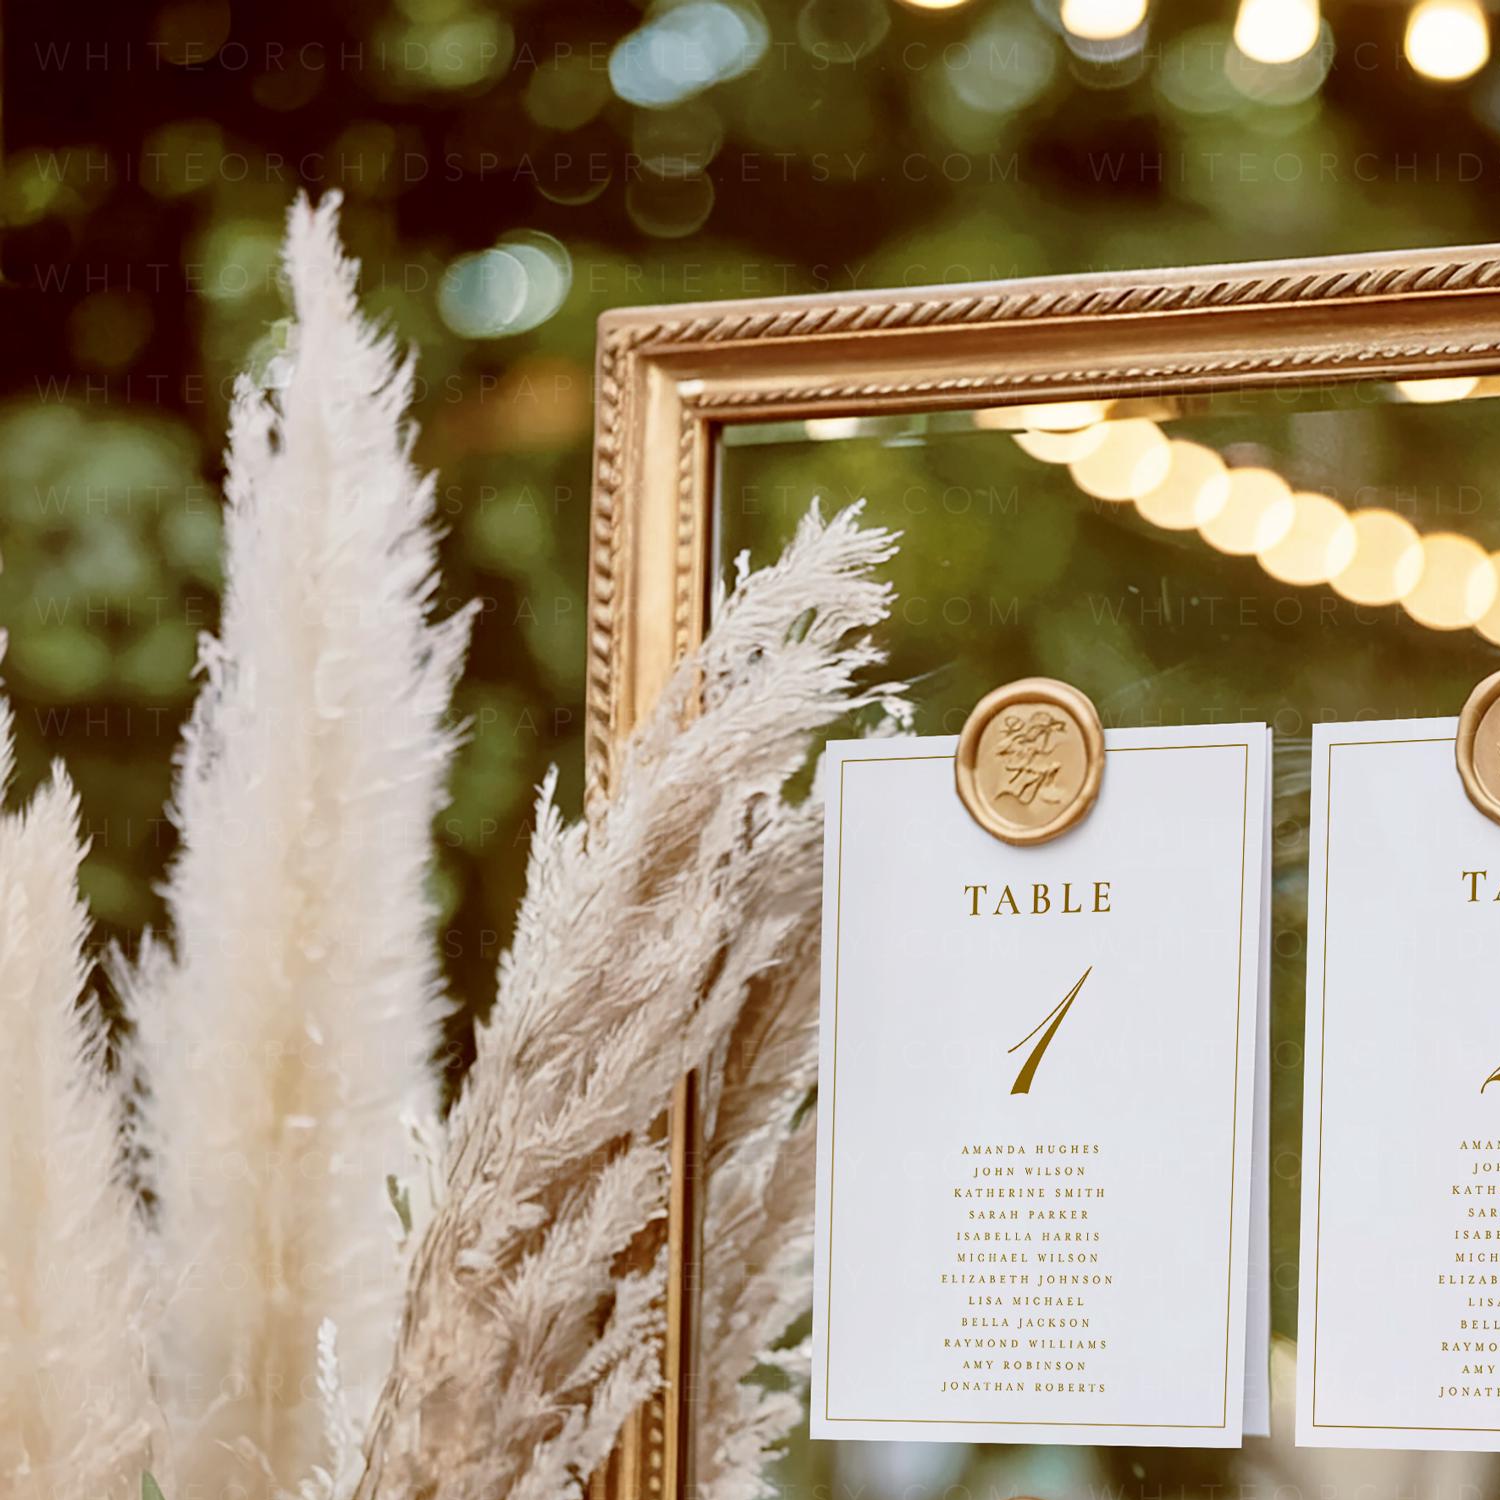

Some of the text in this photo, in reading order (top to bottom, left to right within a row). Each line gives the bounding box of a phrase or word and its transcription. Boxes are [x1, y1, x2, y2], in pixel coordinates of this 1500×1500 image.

[964, 882, 1111, 916] TABLE
[1008, 966, 1093, 1095] 1
[961, 1144, 1099, 1155] AMANDA HUGHES
[973, 1166, 1085, 1179] JOHN WILSON
[954, 1187, 1104, 1198] KATHERINE SMITH
[969, 1210, 1088, 1220] SARAH PARKER
[956, 1231, 1100, 1242] ISABELLA HARRIS
[957, 1252, 1098, 1264] MICHAEL WILSON
[941, 1274, 1112, 1287] ELIZABETH JOHNSON
[961, 1317, 1089, 1330] BELLA JACKSON
[944, 1338, 1106, 1350] RAYMOND WILLIAMS
[1461, 1364, 1495, 1374] AMY
[941, 1381, 1105, 1393] JONATHAN ROBERTS
